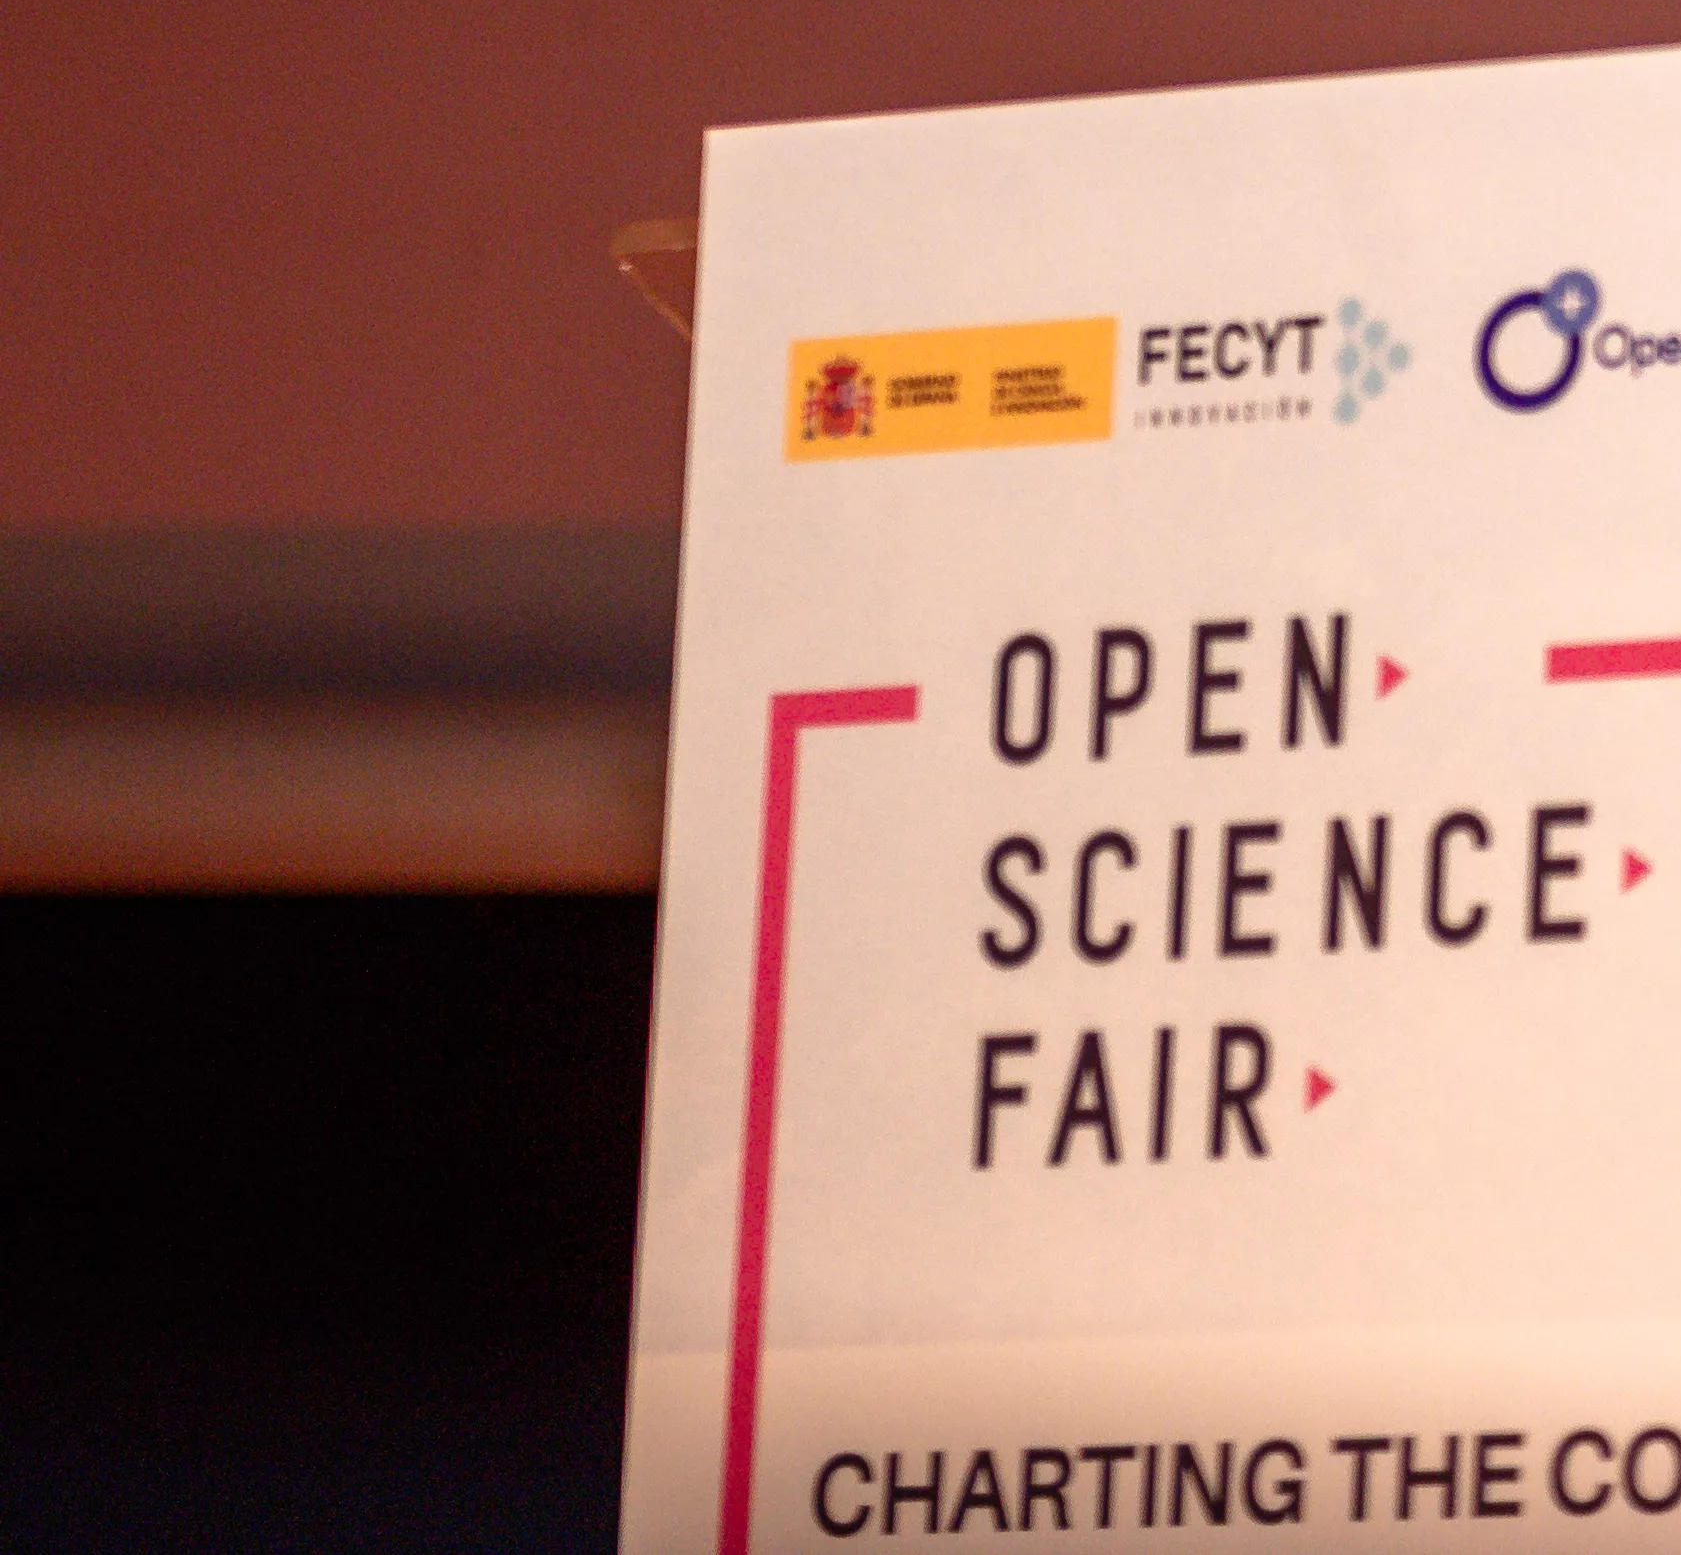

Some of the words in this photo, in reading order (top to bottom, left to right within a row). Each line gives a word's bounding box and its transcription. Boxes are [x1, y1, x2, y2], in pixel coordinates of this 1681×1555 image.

[1135, 312, 1327, 387] FECYT
[989, 611, 1350, 767] OPEN
[976, 801, 1594, 971] SCIENCE
[970, 1020, 1272, 1171] FAIR
[810, 1437, 1308, 1539] CHARTING
[1330, 1430, 1527, 1522] THE
